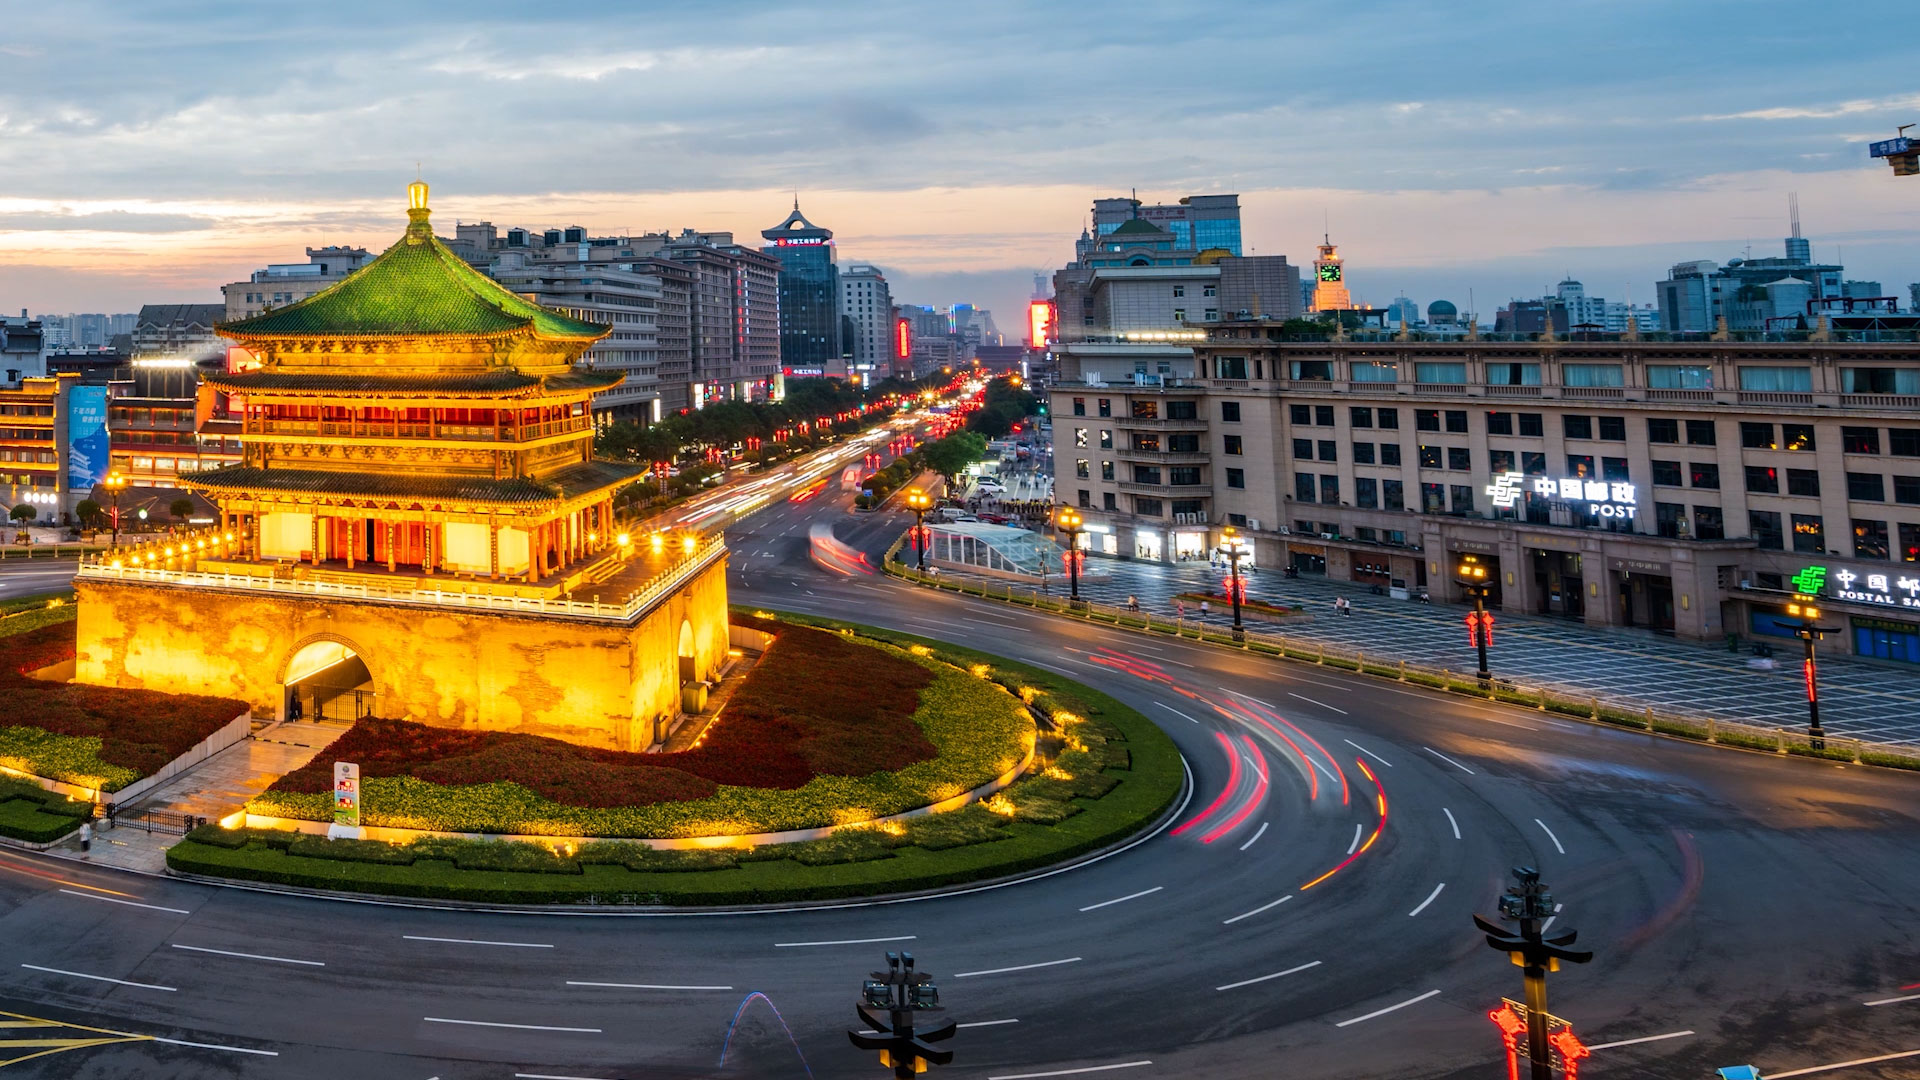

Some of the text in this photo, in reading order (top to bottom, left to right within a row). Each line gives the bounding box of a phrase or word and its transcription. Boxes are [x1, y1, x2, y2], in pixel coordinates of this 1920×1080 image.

[1534, 476, 1637, 504] 中国邮政
[1590, 503, 1637, 519] POST
[1838, 590, 1895, 605] POSTAL
